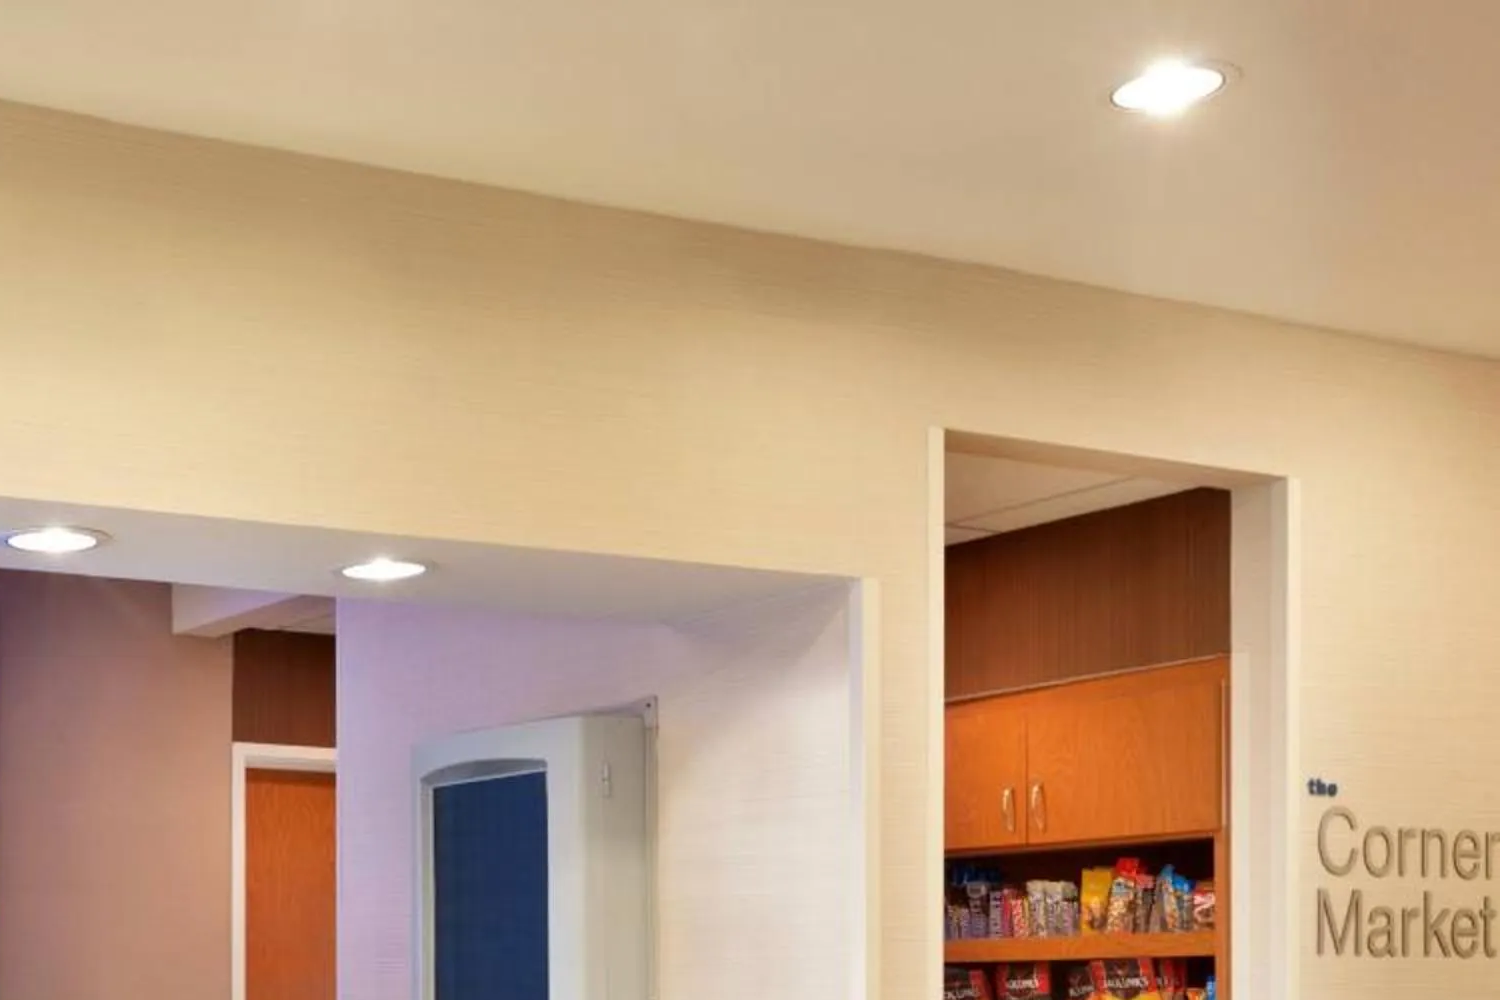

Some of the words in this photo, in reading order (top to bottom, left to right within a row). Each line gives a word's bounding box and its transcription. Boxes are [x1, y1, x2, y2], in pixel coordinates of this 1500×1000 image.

[1308, 778, 1338, 797] the
[1317, 805, 1500, 880] Corner
[1316, 887, 1497, 960] Market
